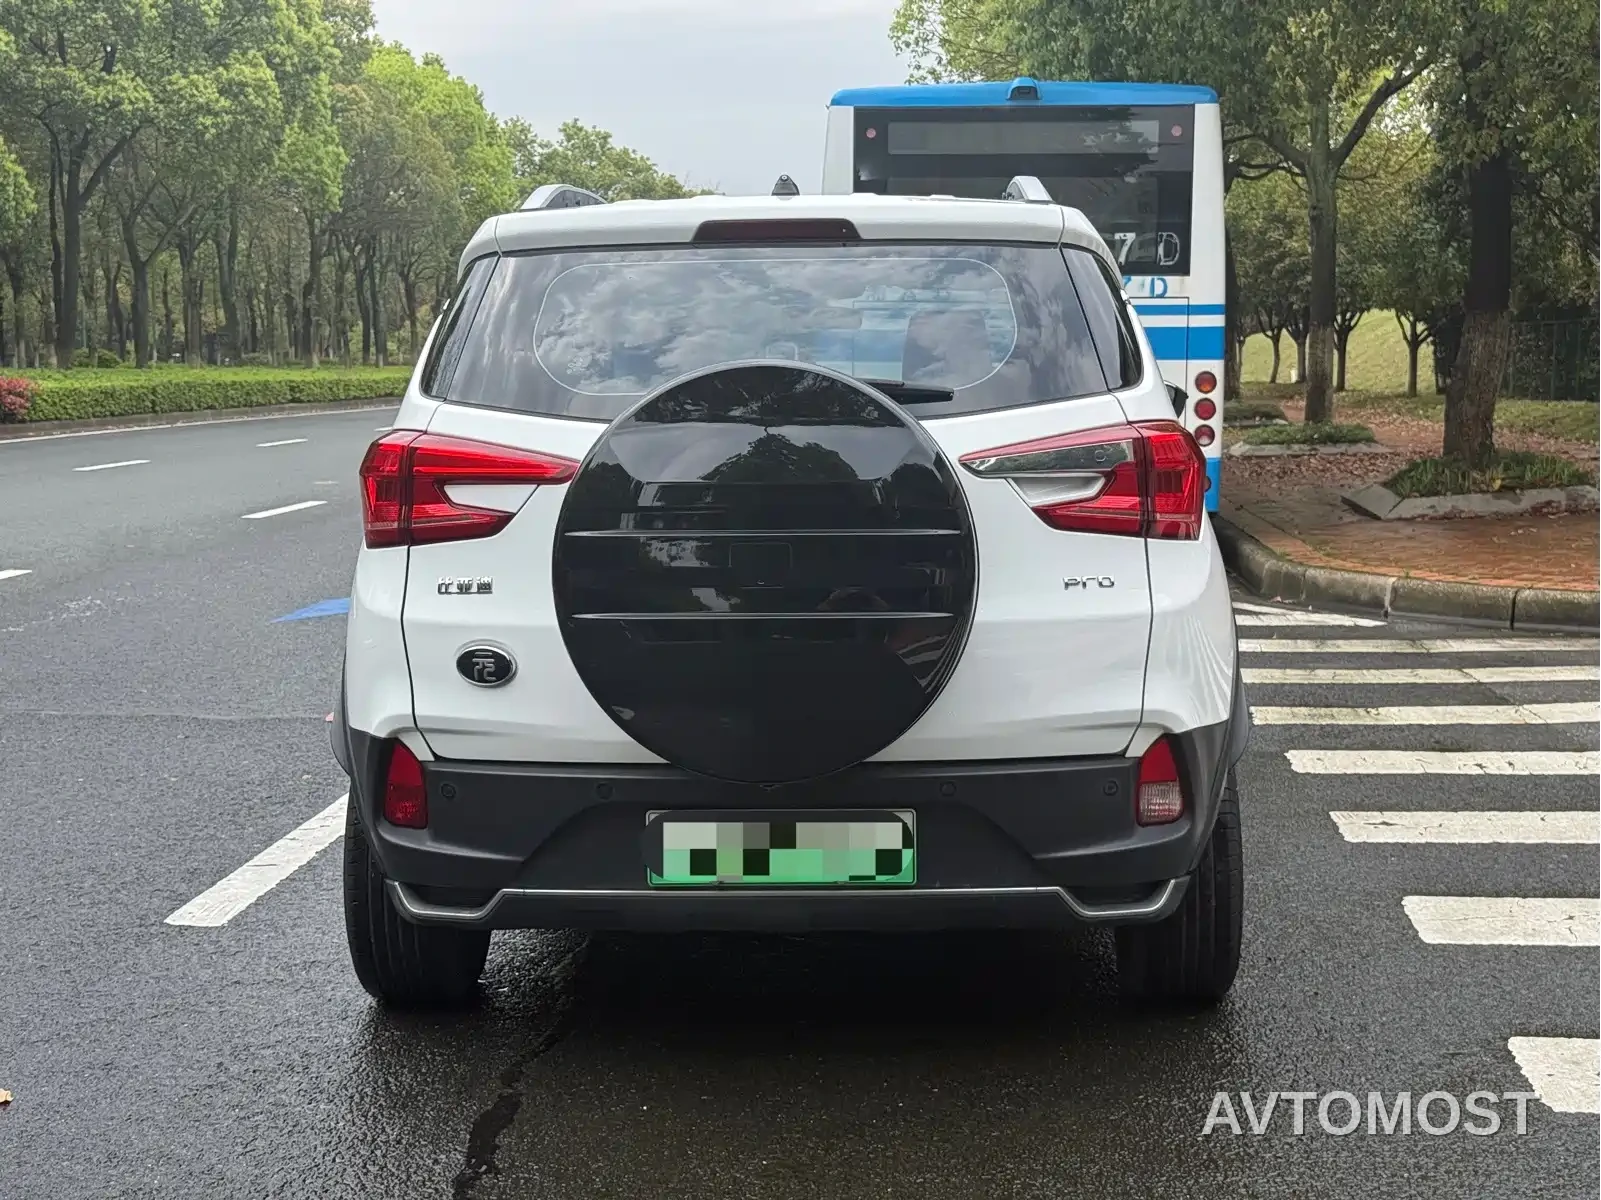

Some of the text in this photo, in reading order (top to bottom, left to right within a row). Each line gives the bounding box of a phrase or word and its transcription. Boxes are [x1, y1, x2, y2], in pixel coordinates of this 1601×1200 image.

[1156, 231, 1180, 266] D
[437, 576, 493, 594] 比亚迪
[472, 651, 497, 681] 元
